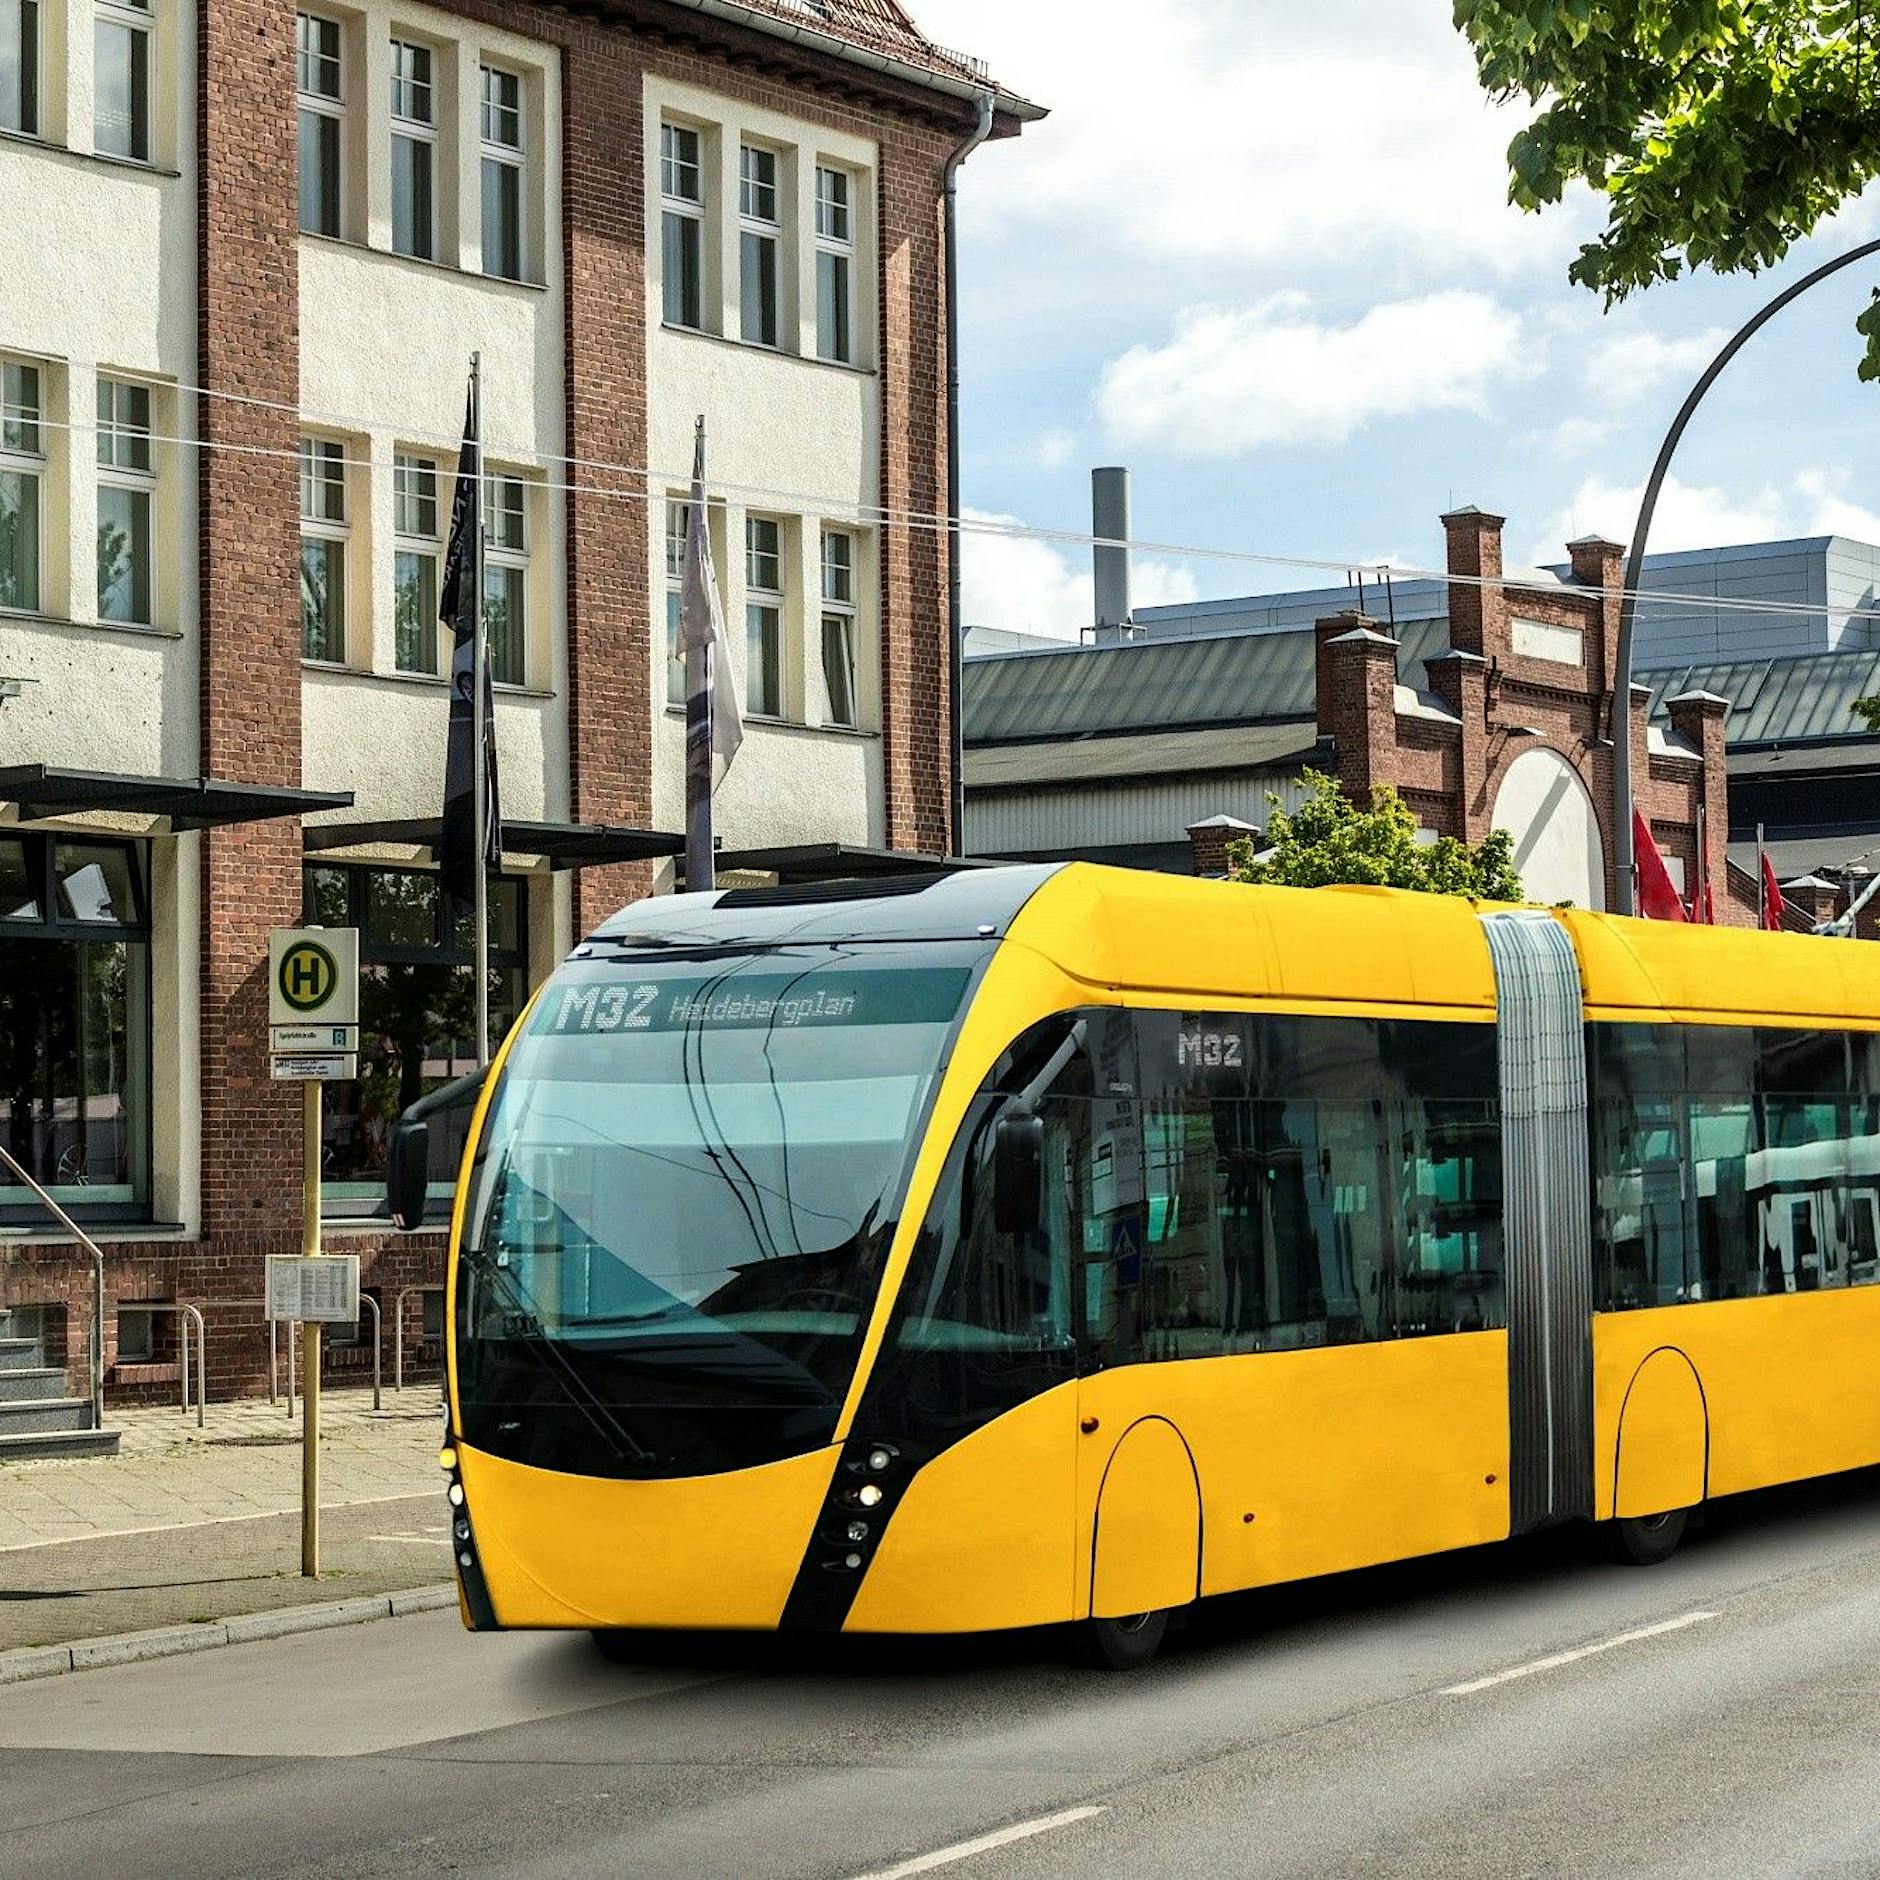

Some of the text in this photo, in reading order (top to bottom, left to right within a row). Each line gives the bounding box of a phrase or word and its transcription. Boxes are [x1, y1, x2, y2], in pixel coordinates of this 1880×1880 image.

[293, 957, 319, 995] H
[555, 985, 659, 1029] M32
[1179, 1033, 1242, 1067] M32
